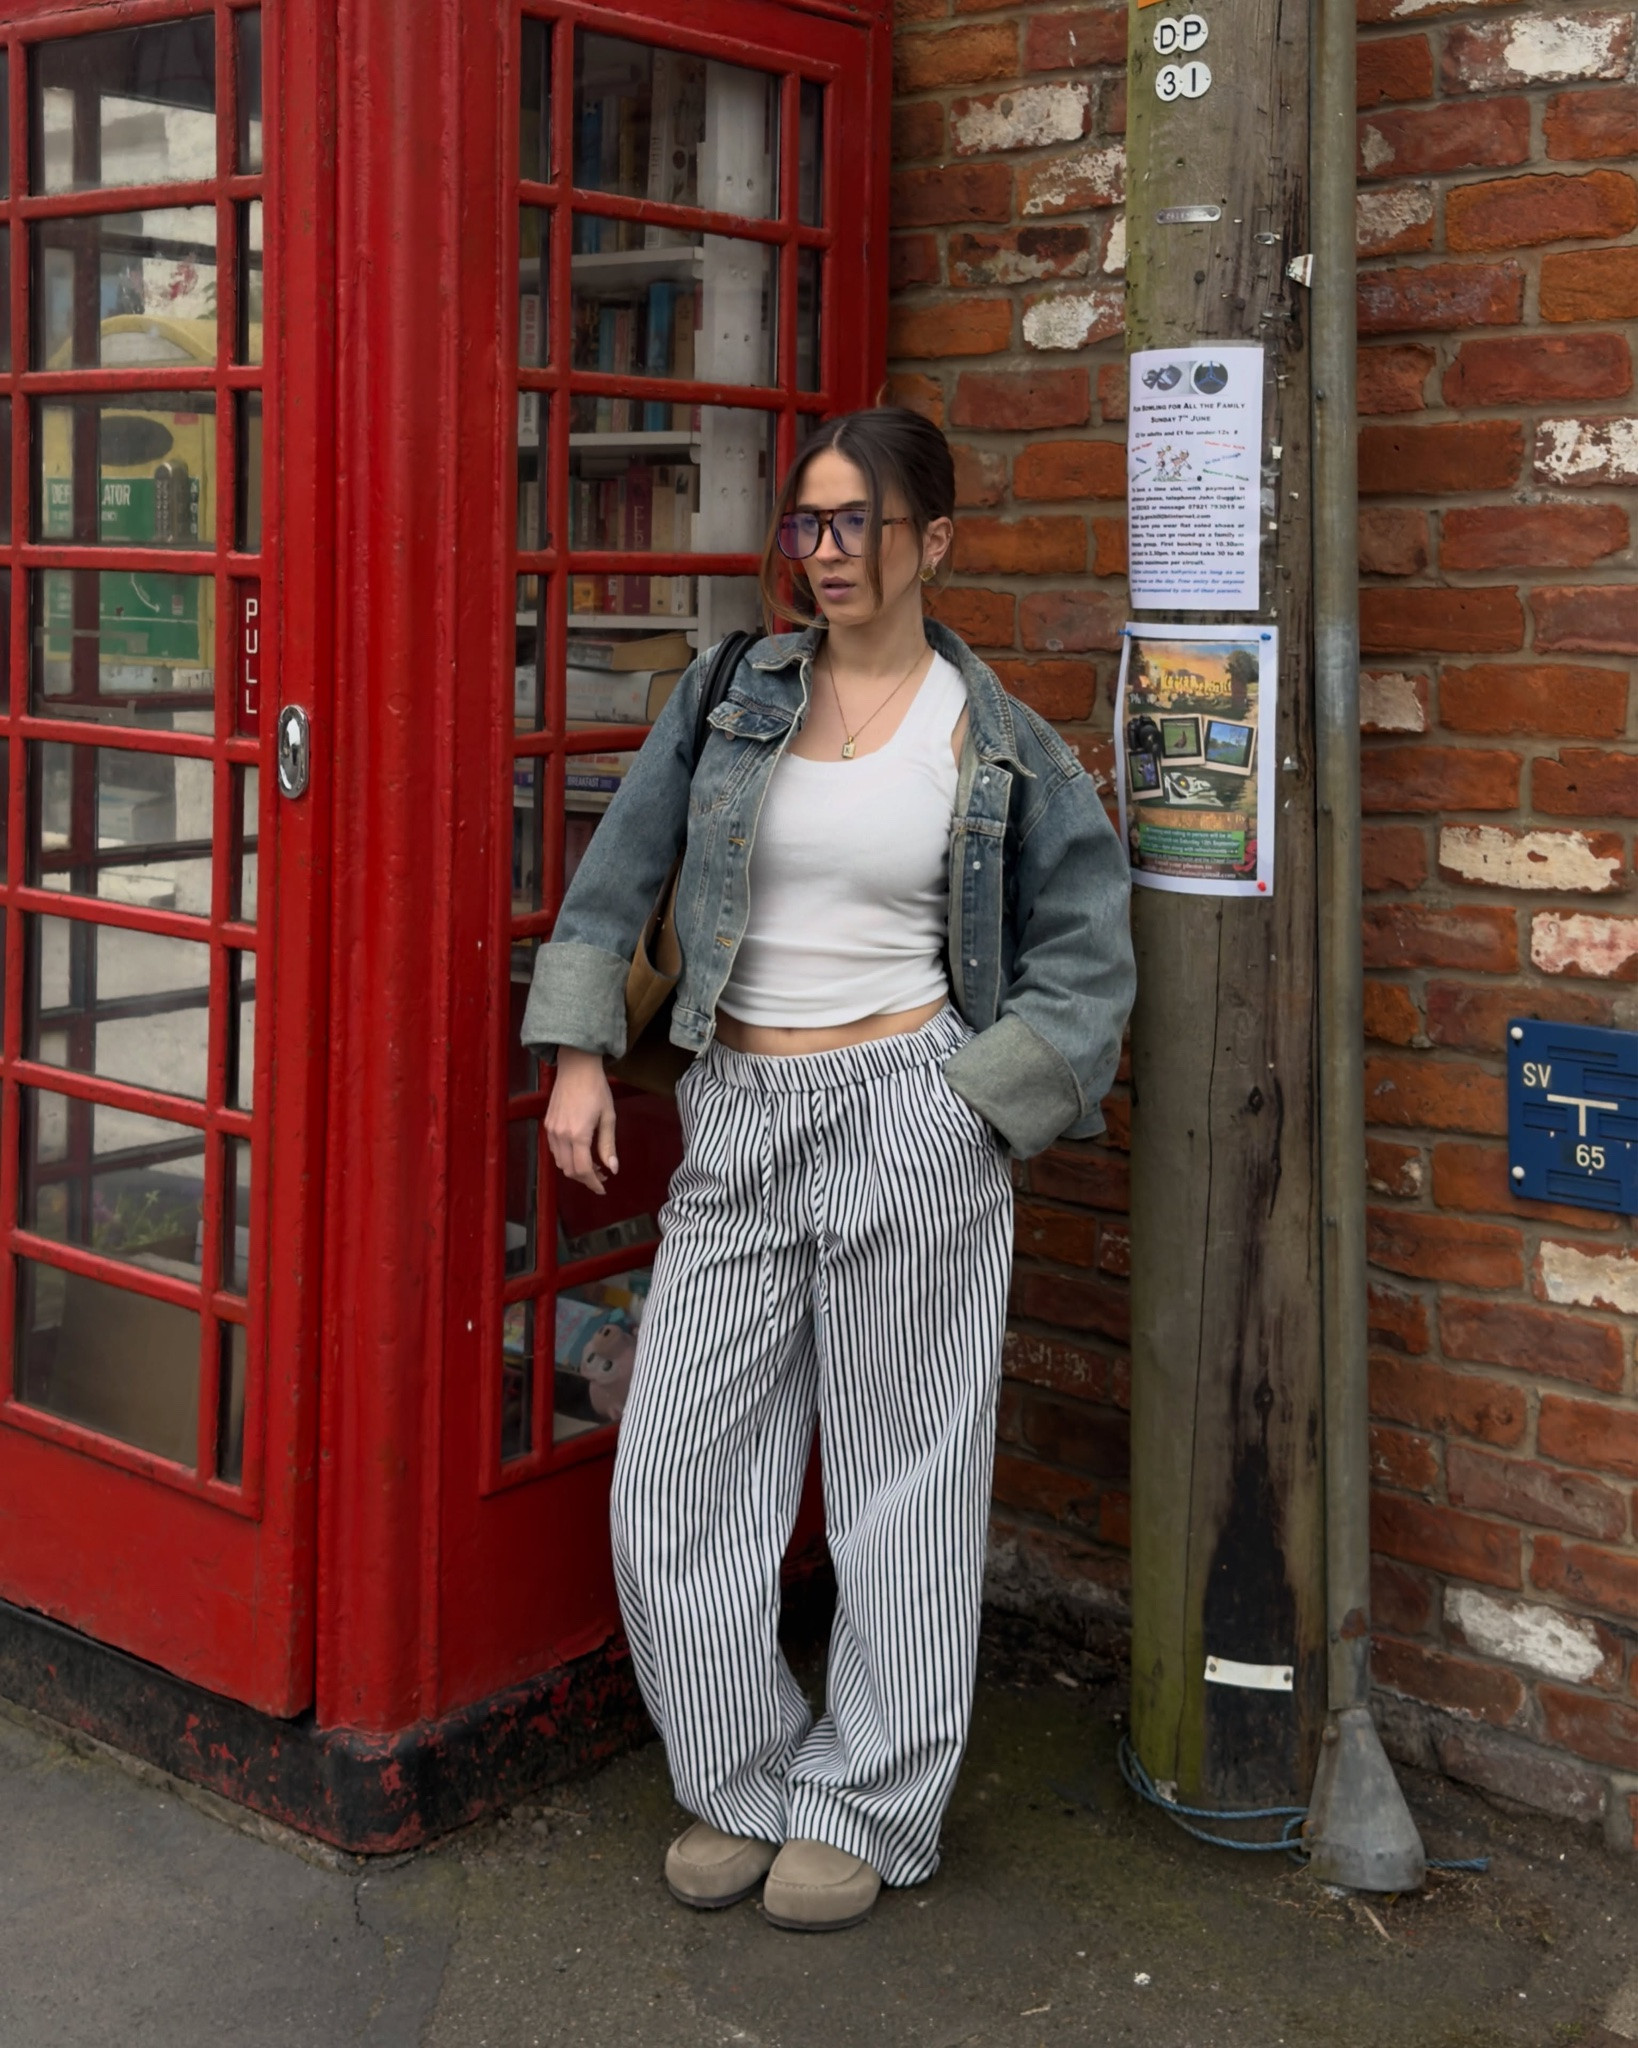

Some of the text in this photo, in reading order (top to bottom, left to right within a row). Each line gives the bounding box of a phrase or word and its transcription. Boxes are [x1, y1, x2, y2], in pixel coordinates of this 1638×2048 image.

[1160, 20, 1202, 49] DP
[1163, 68, 1197, 96] 31
[1142, 404, 1167, 412] BOWLING
[245, 598, 258, 715] PULL
[567, 776, 599, 788] BREAKFAST
[1523, 1062, 1552, 1088] SV
[1576, 1144, 1606, 1170] 65
